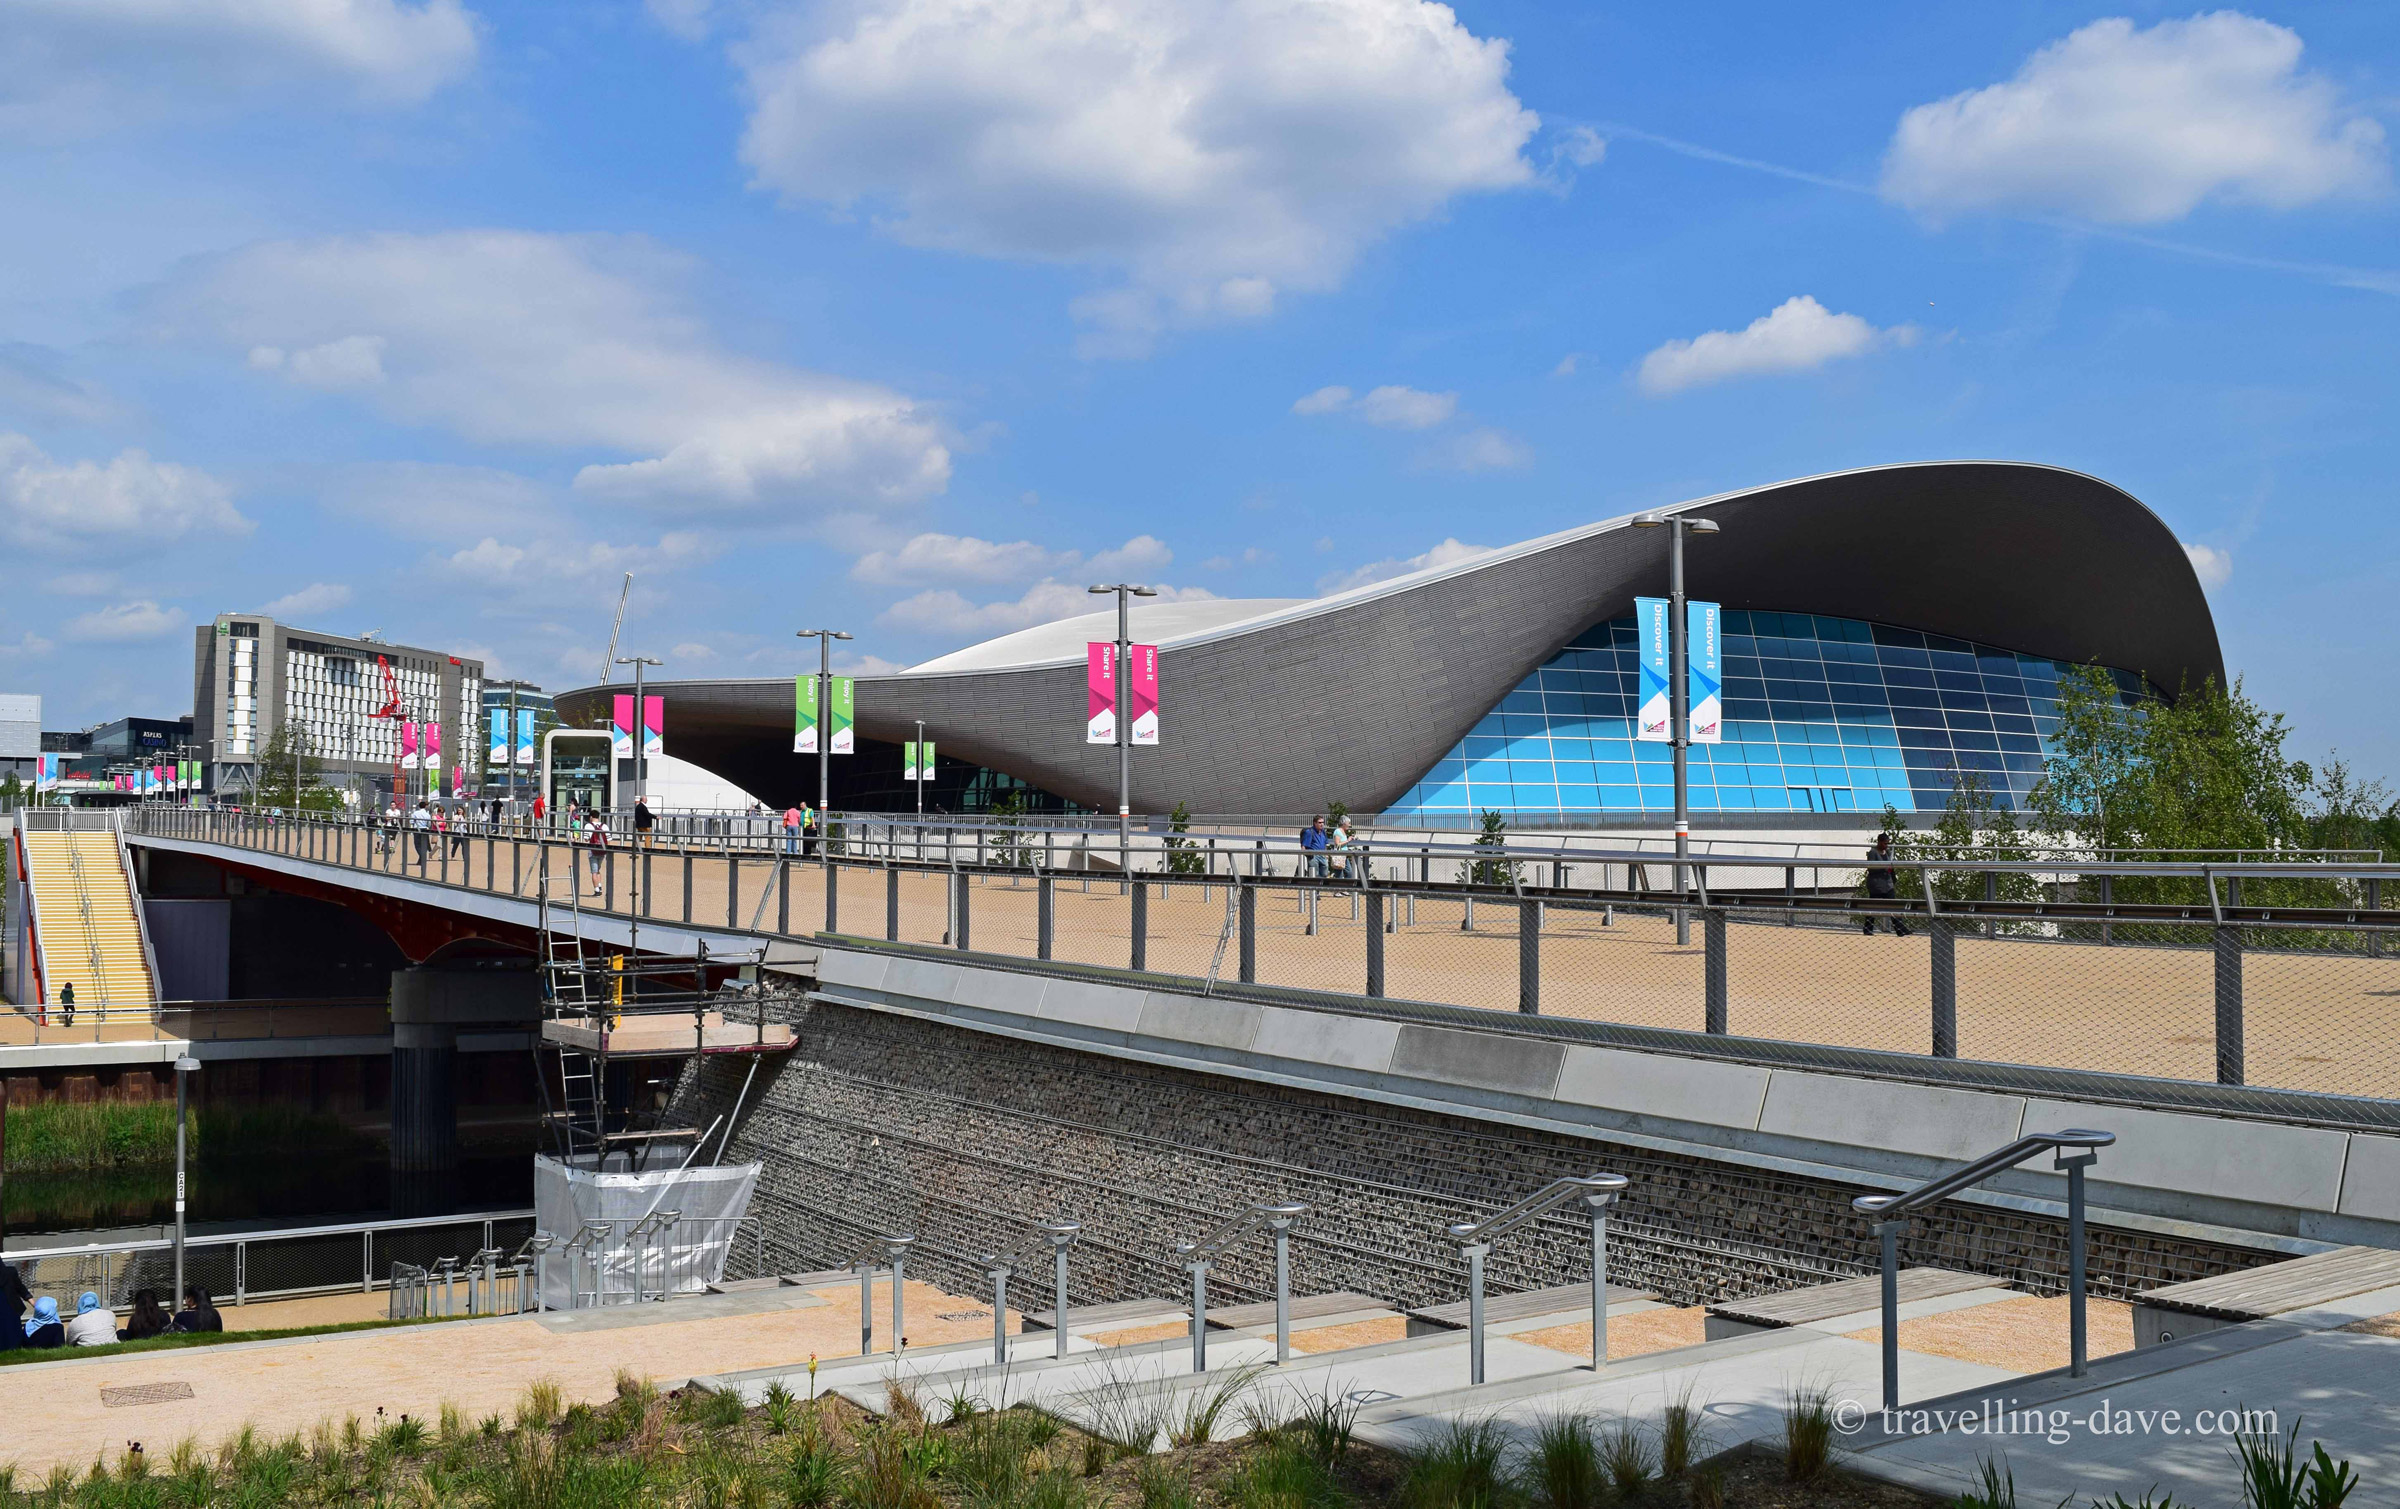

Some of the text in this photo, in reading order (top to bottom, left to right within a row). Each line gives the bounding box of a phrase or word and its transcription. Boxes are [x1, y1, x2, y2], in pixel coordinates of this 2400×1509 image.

[1654, 604, 1664, 667] Discover it
[1706, 609, 1715, 670] Discover it
[1103, 646, 1111, 671] Share
[142, 738, 167, 747] CASINO
